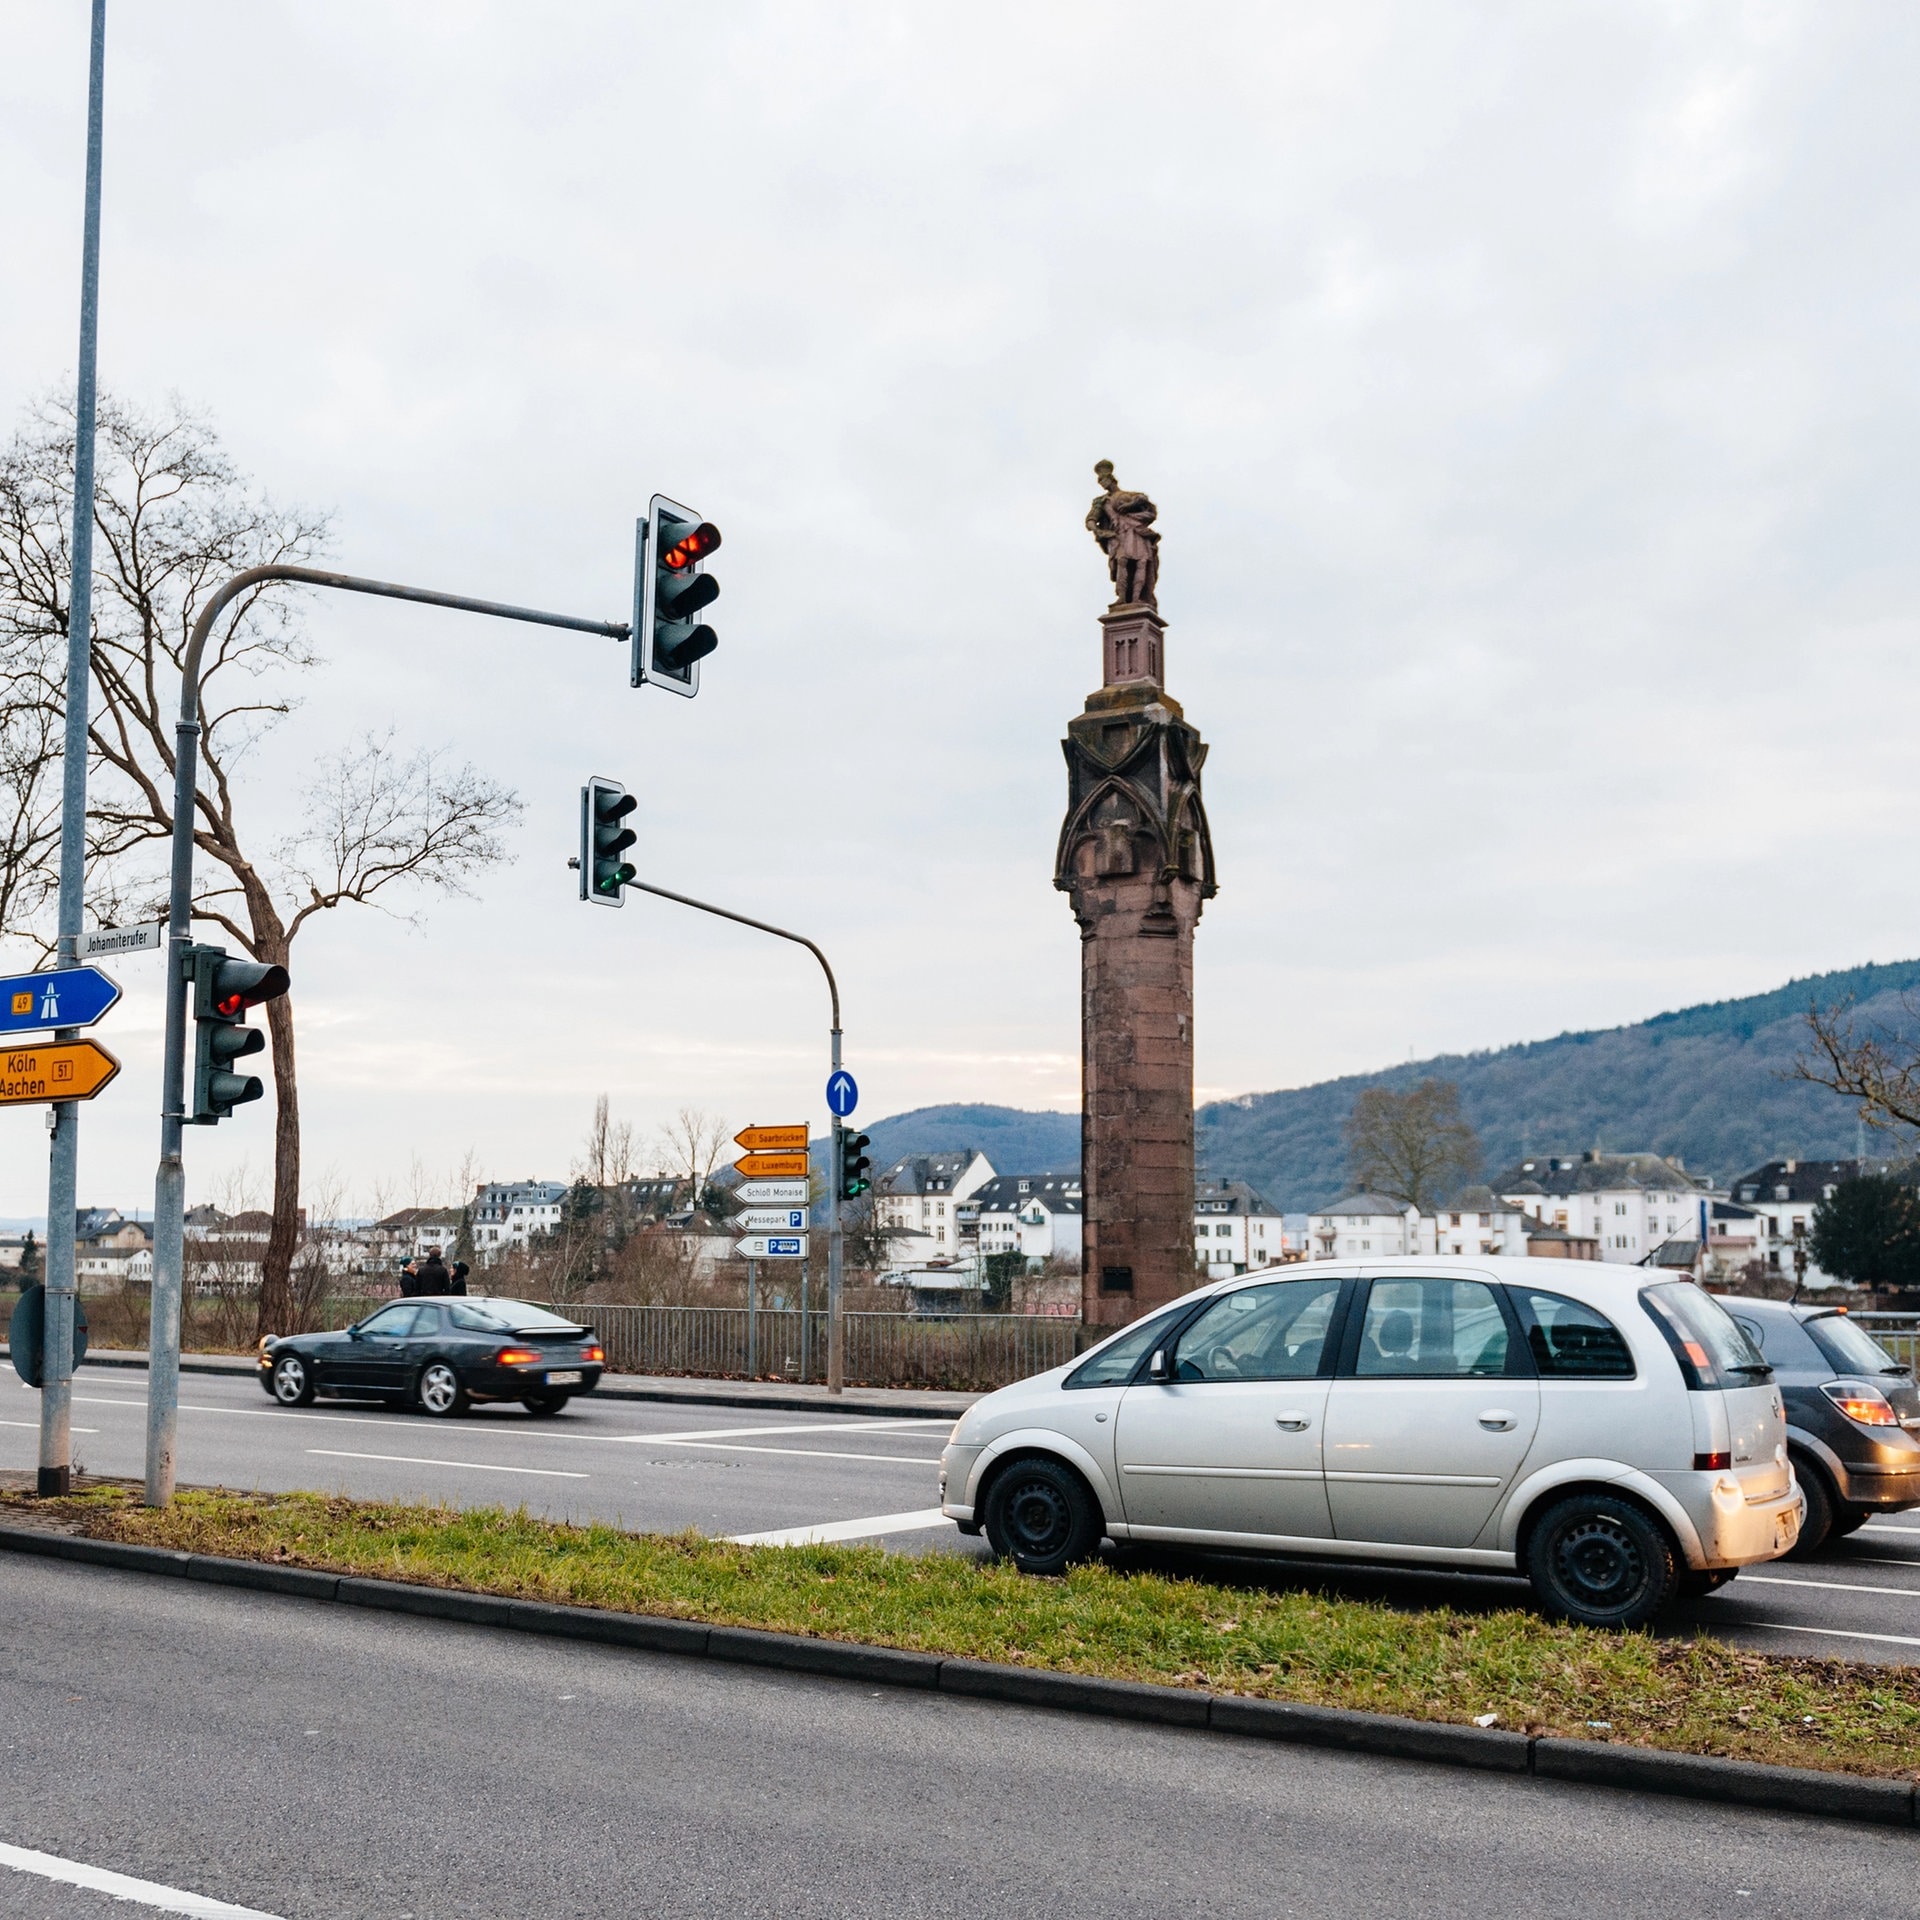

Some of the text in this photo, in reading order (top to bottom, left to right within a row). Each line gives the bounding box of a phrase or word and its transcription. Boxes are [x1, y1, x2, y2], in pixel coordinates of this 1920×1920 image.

[87, 930, 148, 953] Johanniterufer
[17, 997, 28, 1009] 49
[8, 1054, 36, 1073] Köln
[58, 1066, 68, 1078] 51
[0, 1077, 45, 1096] Aachen
[759, 1132, 804, 1143] Saarbrücken
[761, 1161, 803, 1171] Luxemburg
[747, 1188, 803, 1197] Schloß Monaise
[748, 1215, 787, 1224] Messepark
[792, 1213, 800, 1225] P
[770, 1242, 777, 1252] P
